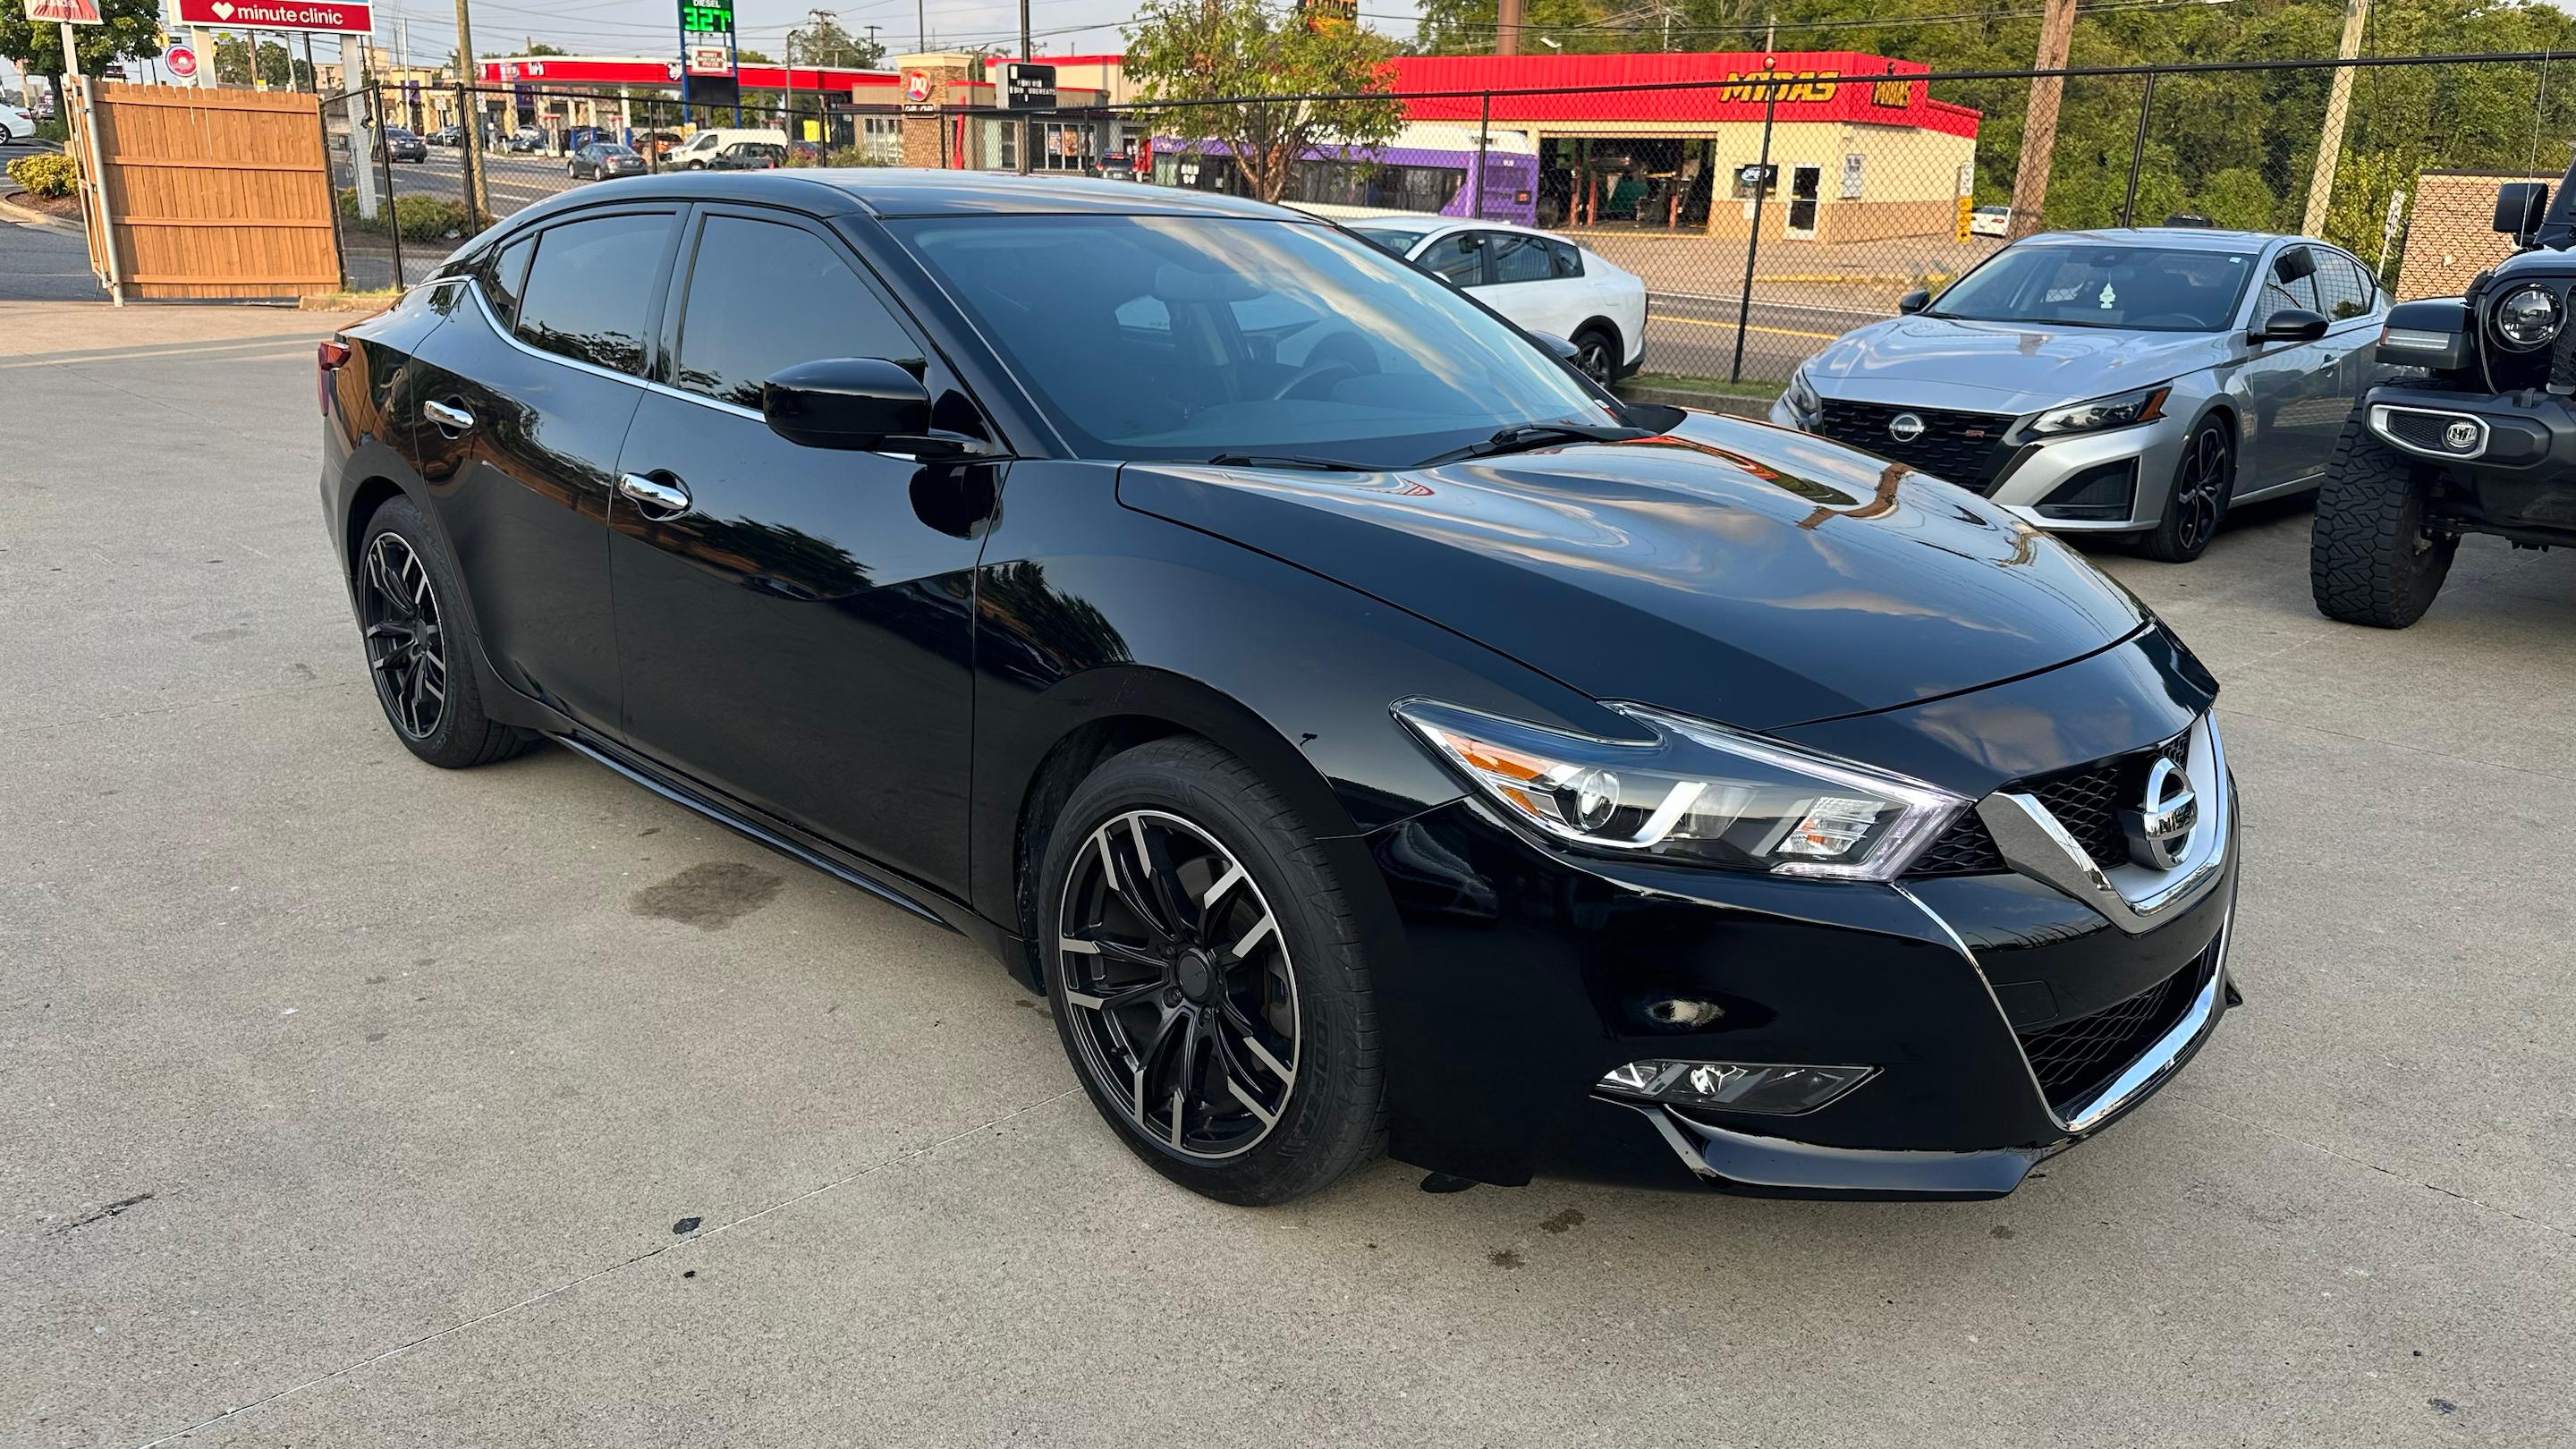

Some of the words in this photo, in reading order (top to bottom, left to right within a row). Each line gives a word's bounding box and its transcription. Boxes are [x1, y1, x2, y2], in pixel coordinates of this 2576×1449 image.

[693, 0, 721, 8] DIESEL
[237, 5, 297, 22] minute
[299, 8, 343, 25] clinic
[911, 77, 927, 95] DQ
[1719, 71, 1839, 102] MIDAS
[2157, 801, 2196, 835] NISS
